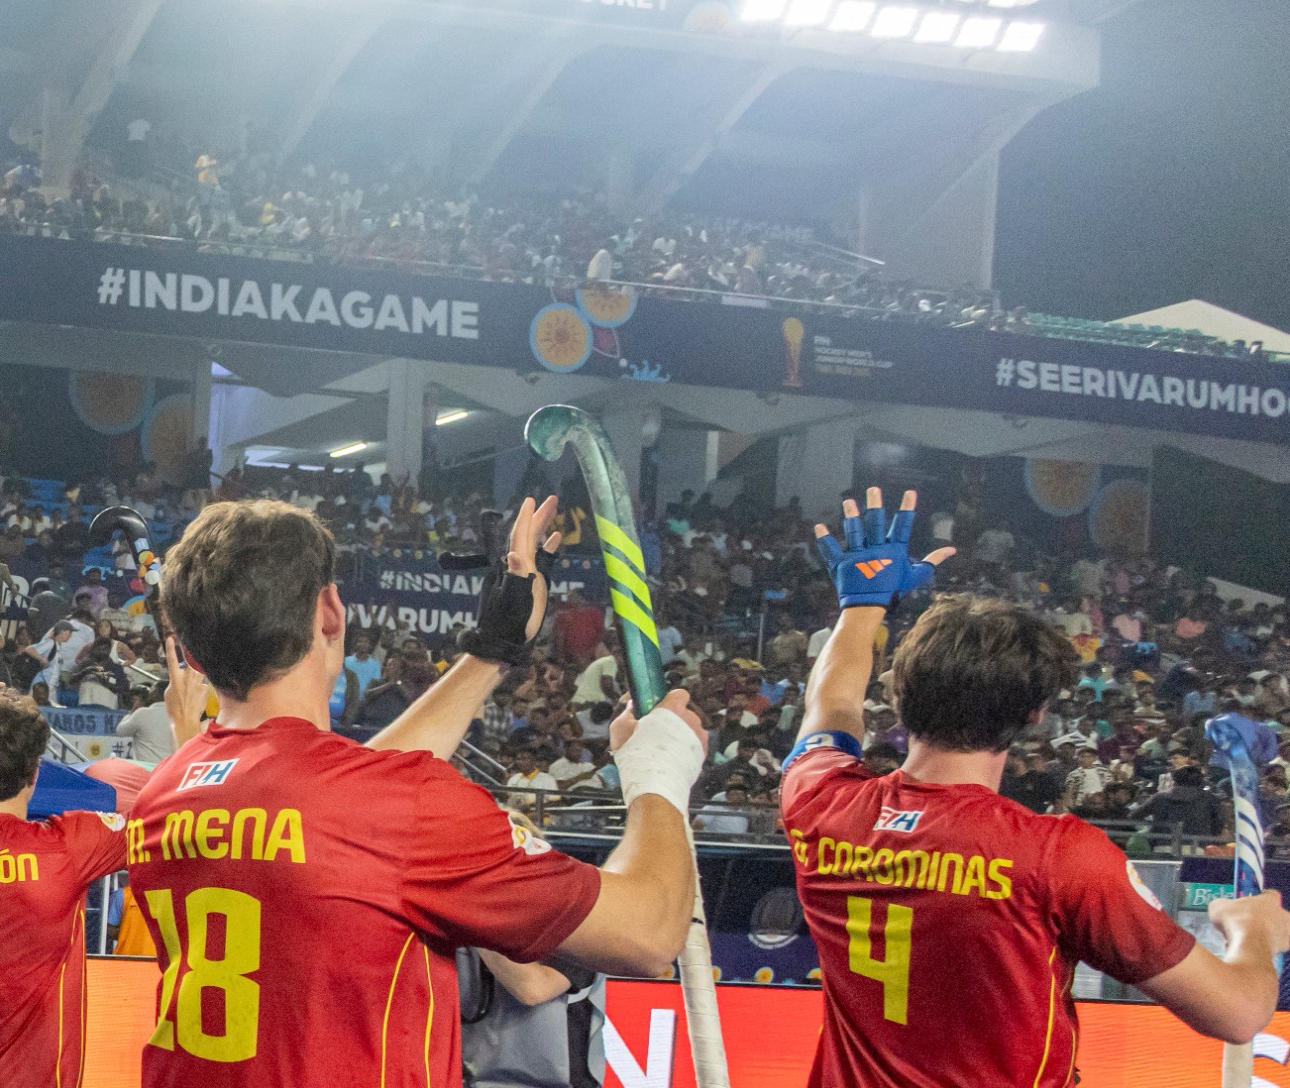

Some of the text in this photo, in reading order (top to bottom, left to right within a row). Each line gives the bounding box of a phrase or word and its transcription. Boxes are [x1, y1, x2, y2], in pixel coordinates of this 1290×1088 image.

[97, 267, 480, 340] #INDIAKAGAME
[994, 357, 1290, 418] #SEERIVARUMHO
[179, 759, 237, 792] FIH
[160, 807, 307, 864] MENA
[817, 836, 1014, 900] COROMINAS
[144, 886, 262, 1063] 18
[845, 894, 915, 1026] 4
